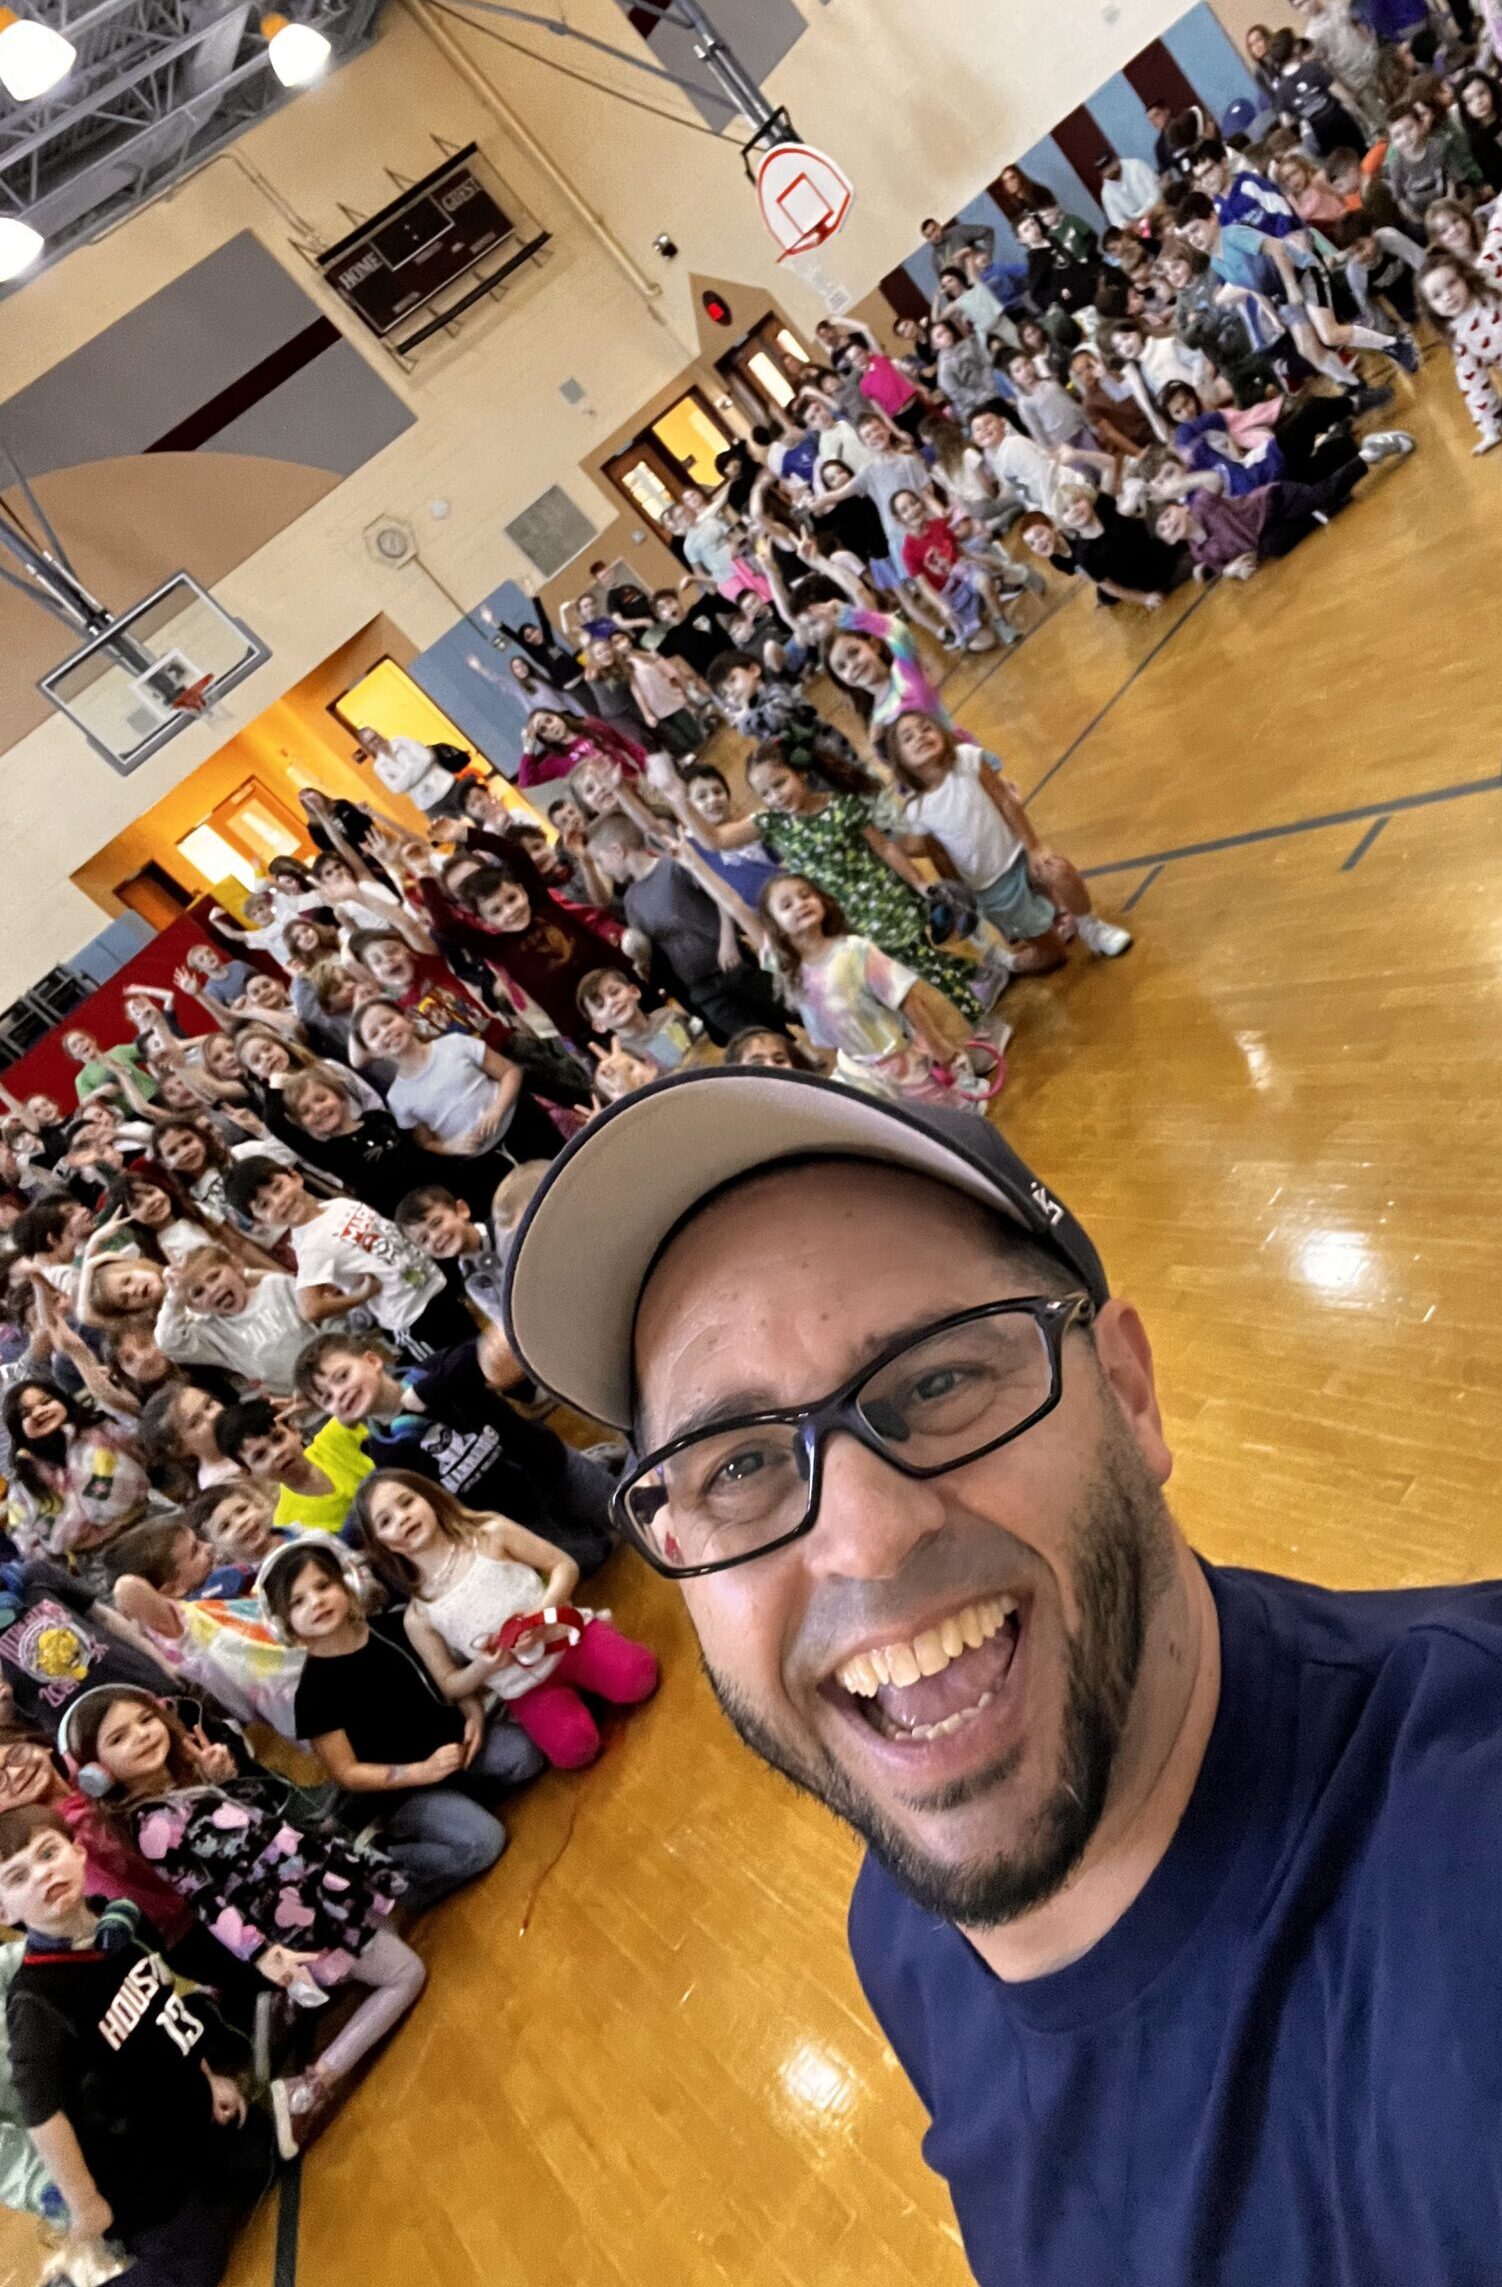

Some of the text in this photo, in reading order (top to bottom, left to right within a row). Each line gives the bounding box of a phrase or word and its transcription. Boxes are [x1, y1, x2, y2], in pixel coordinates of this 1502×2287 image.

[442, 176, 483, 212] GUEST
[338, 251, 385, 291] HOME
[156, 1993, 204, 2057] 13
